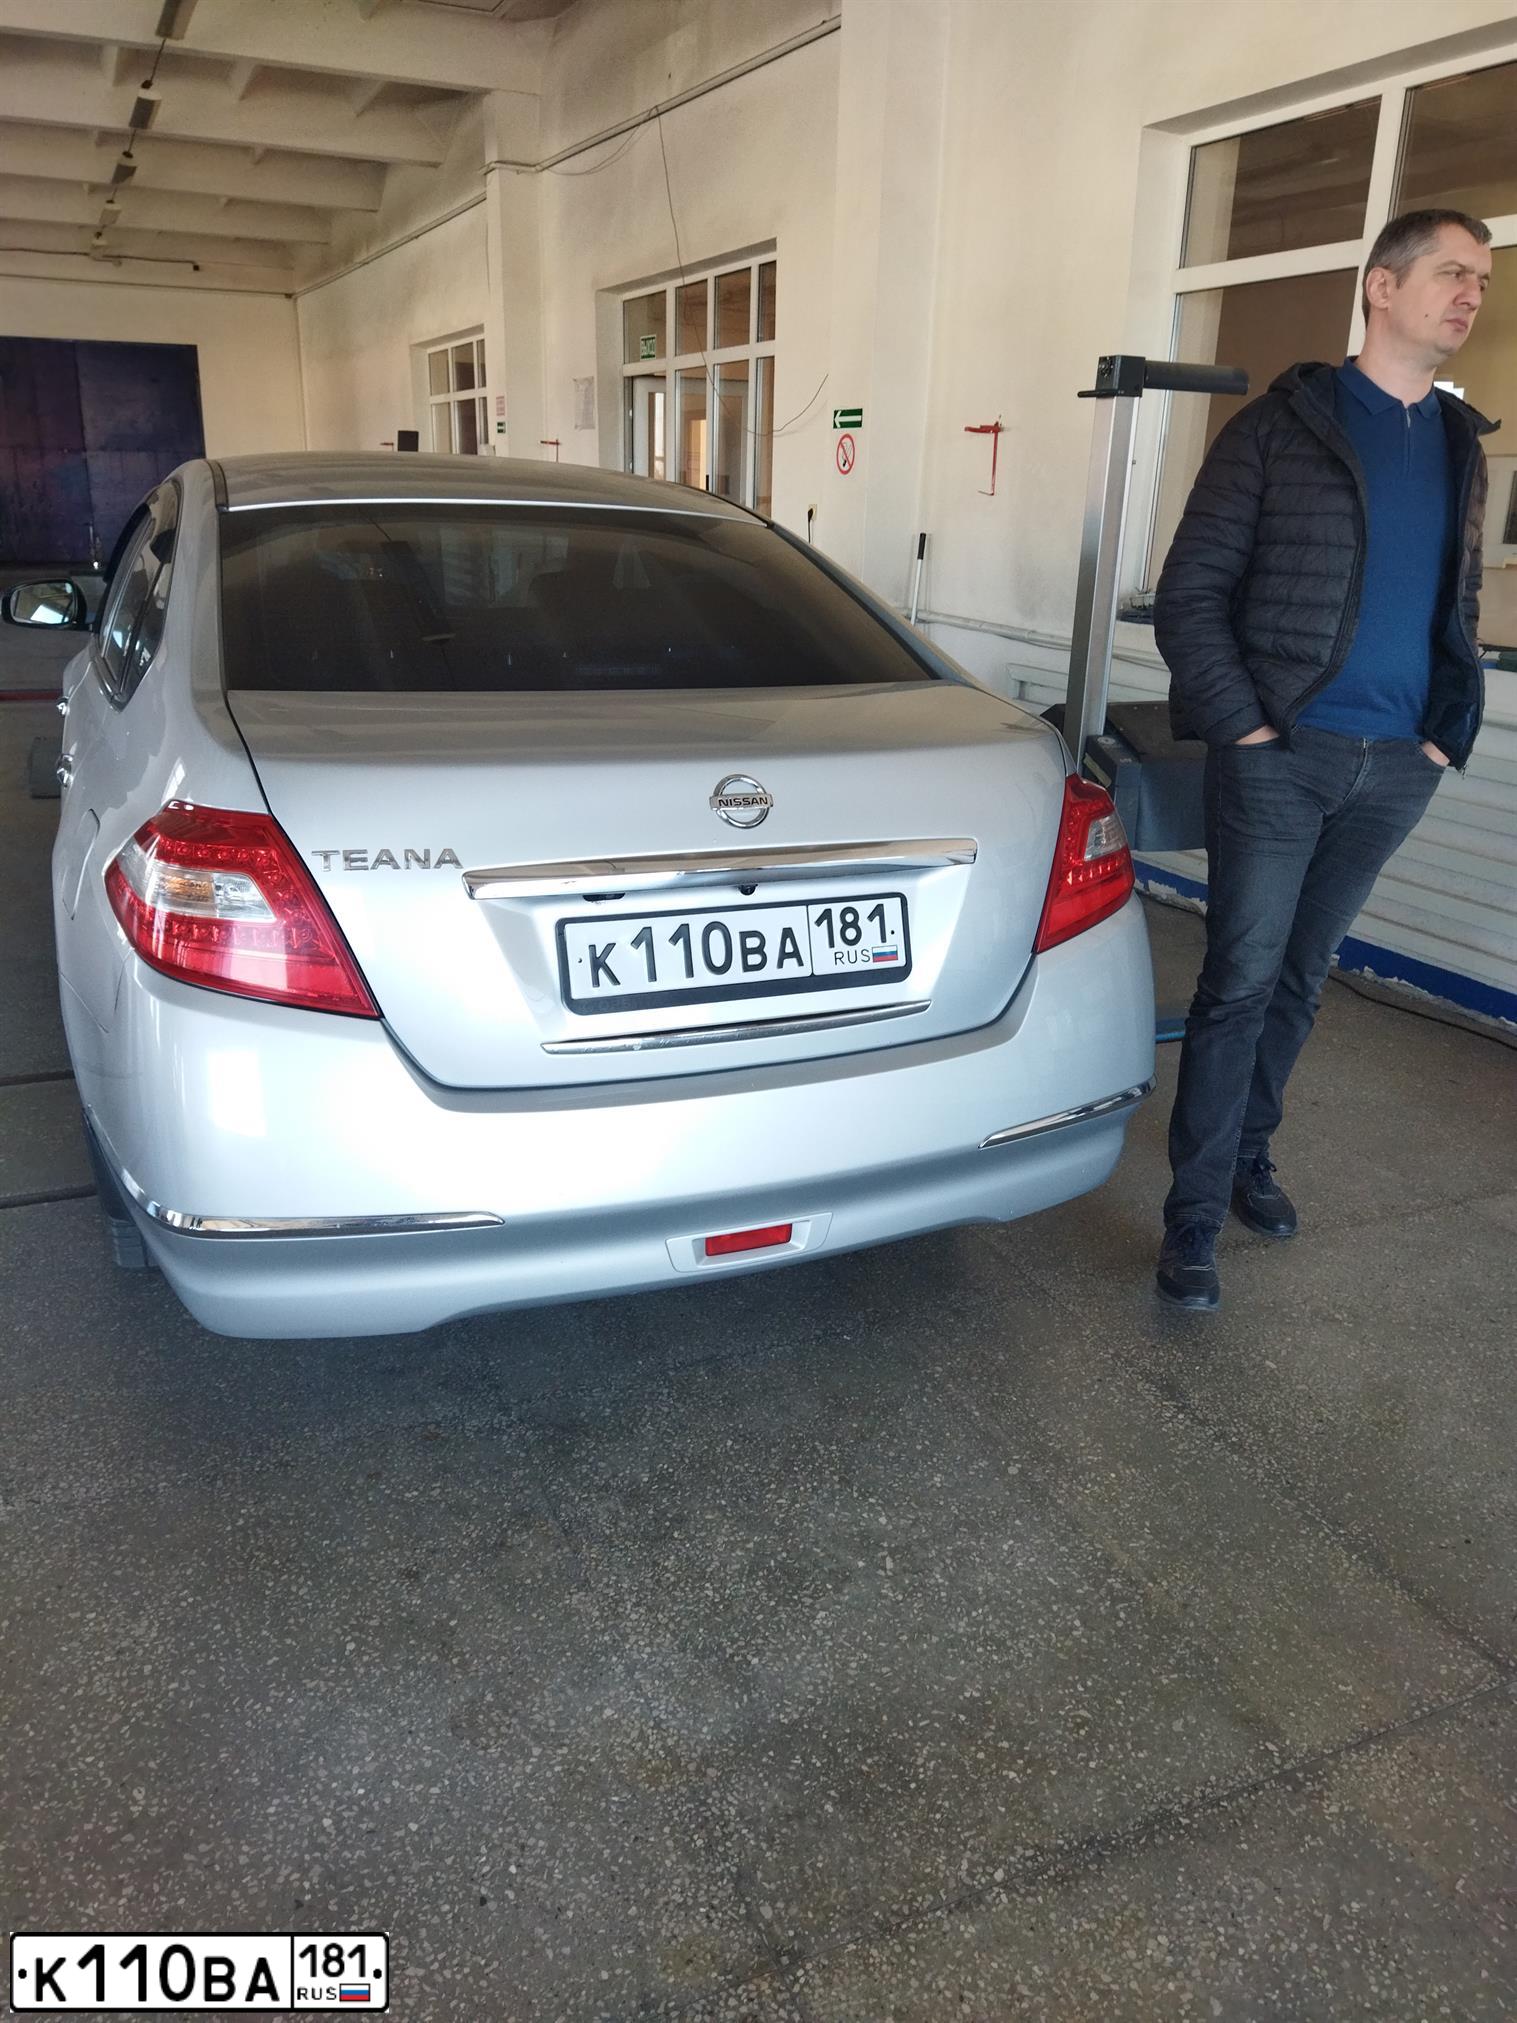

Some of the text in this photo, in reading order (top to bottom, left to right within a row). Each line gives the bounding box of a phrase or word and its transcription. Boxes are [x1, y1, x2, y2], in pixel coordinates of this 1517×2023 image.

[718, 797, 768, 806] NISSAN
[311, 848, 463, 872] TEANA
[814, 903, 888, 948] 181
[834, 949, 871, 965] RUS
